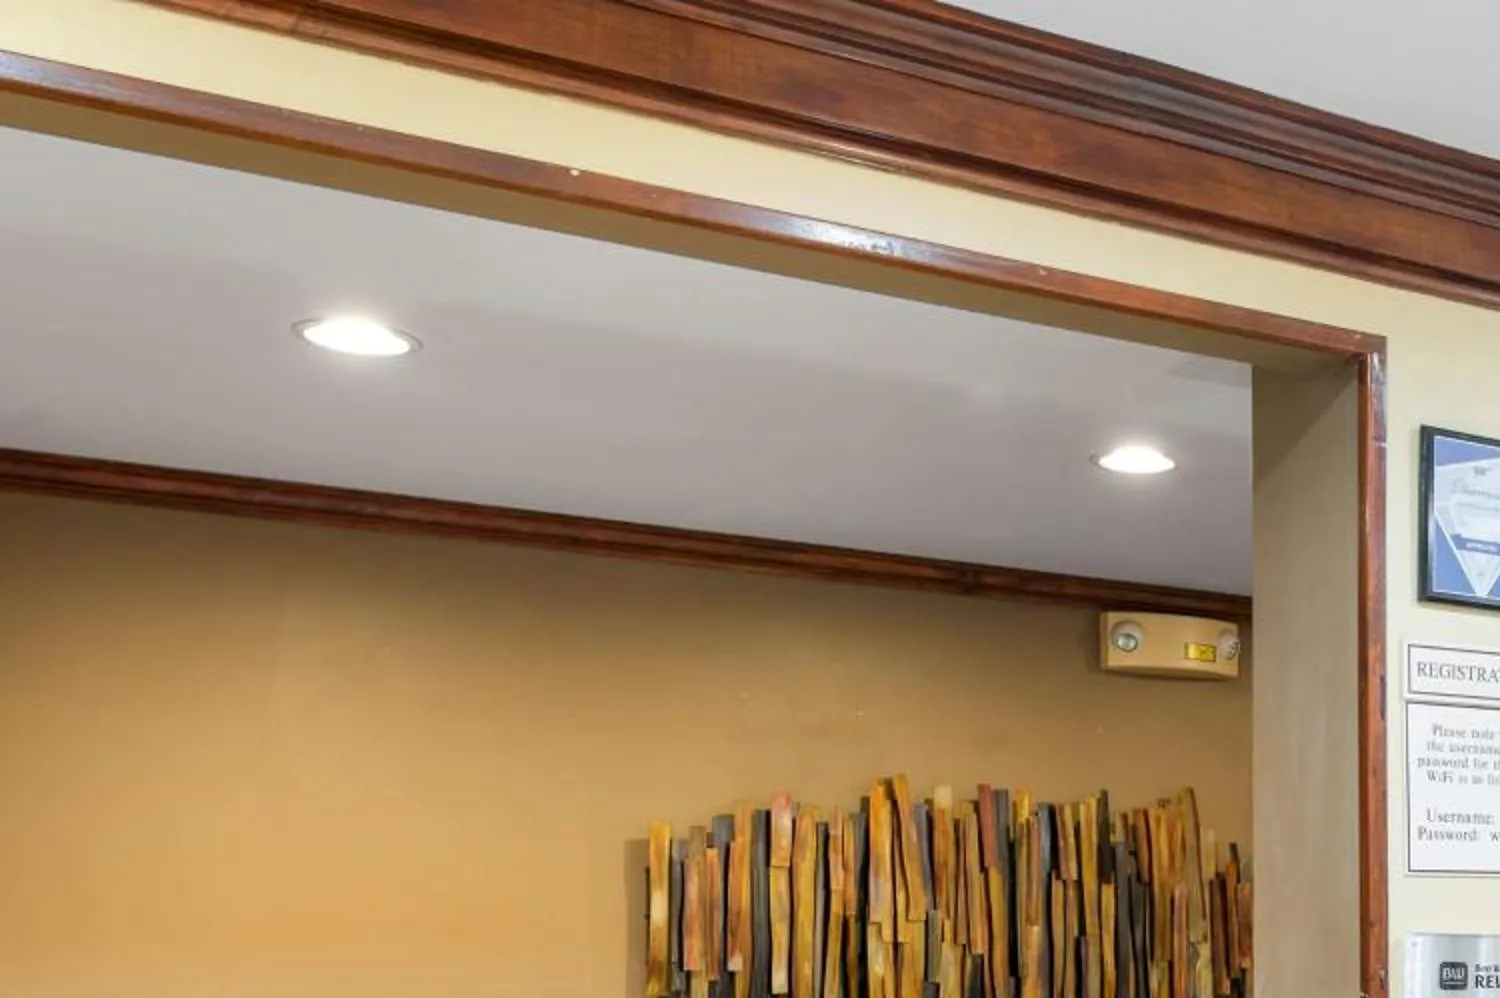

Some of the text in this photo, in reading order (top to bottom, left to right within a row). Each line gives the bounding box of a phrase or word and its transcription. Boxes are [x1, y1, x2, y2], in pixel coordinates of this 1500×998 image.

[1432, 723, 1467, 738] Please
[1471, 728, 1494, 740] note
[1473, 757, 1488, 769] for
